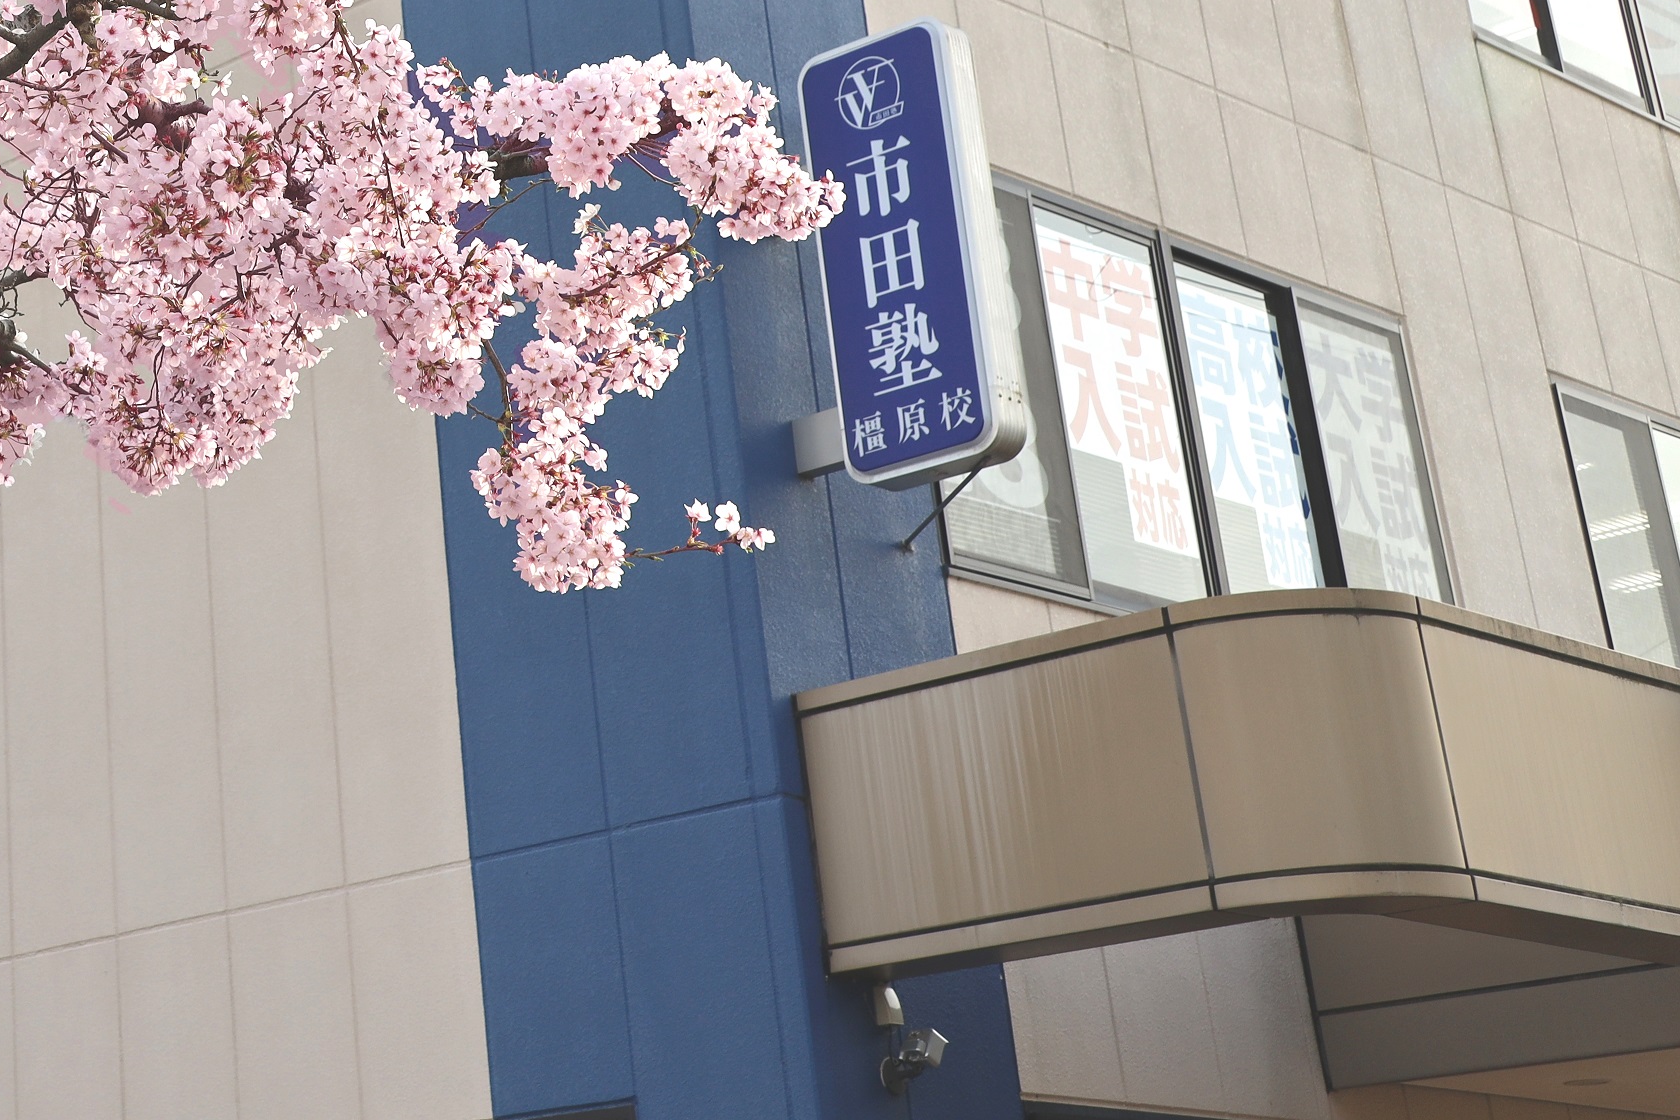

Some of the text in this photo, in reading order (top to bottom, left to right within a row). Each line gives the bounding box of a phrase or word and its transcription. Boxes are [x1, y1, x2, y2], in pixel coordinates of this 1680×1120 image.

[846, 134, 942, 397] 市田塾
[1040, 238, 1159, 357] 中学
[852, 387, 976, 457] 橿原校
[1063, 344, 1180, 473] 入試
[1129, 467, 1188, 550] 対応
